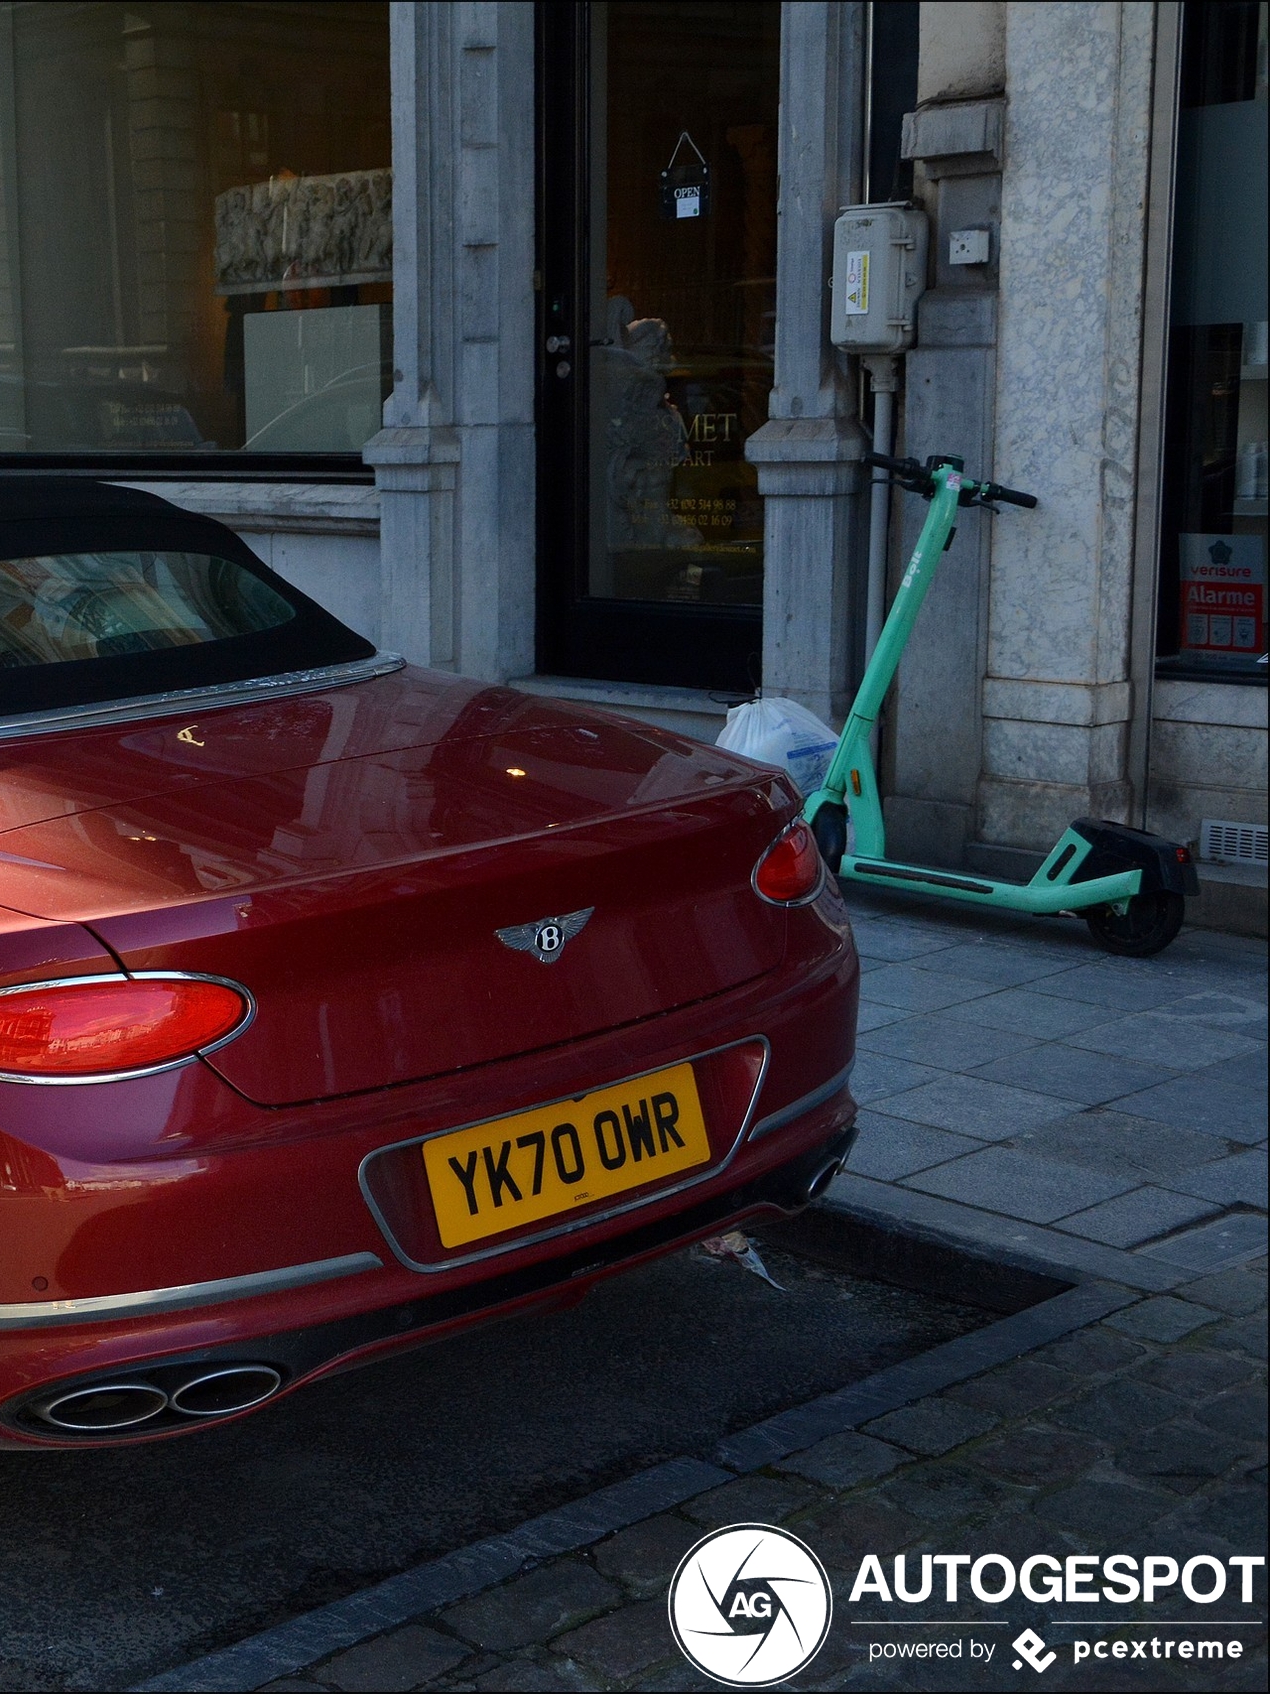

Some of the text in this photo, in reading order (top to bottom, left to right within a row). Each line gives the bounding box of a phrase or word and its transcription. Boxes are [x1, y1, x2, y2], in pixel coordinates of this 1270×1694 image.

[673, 186, 700, 199] OPEN
[682, 450, 714, 467] ART
[901, 550, 923, 588] Bolt
[1190, 565, 1252, 577] verisure
[1188, 585, 1256, 606] Alarme
[541, 926, 560, 951] B
[447, 1091, 686, 1216] YK70 OWR
